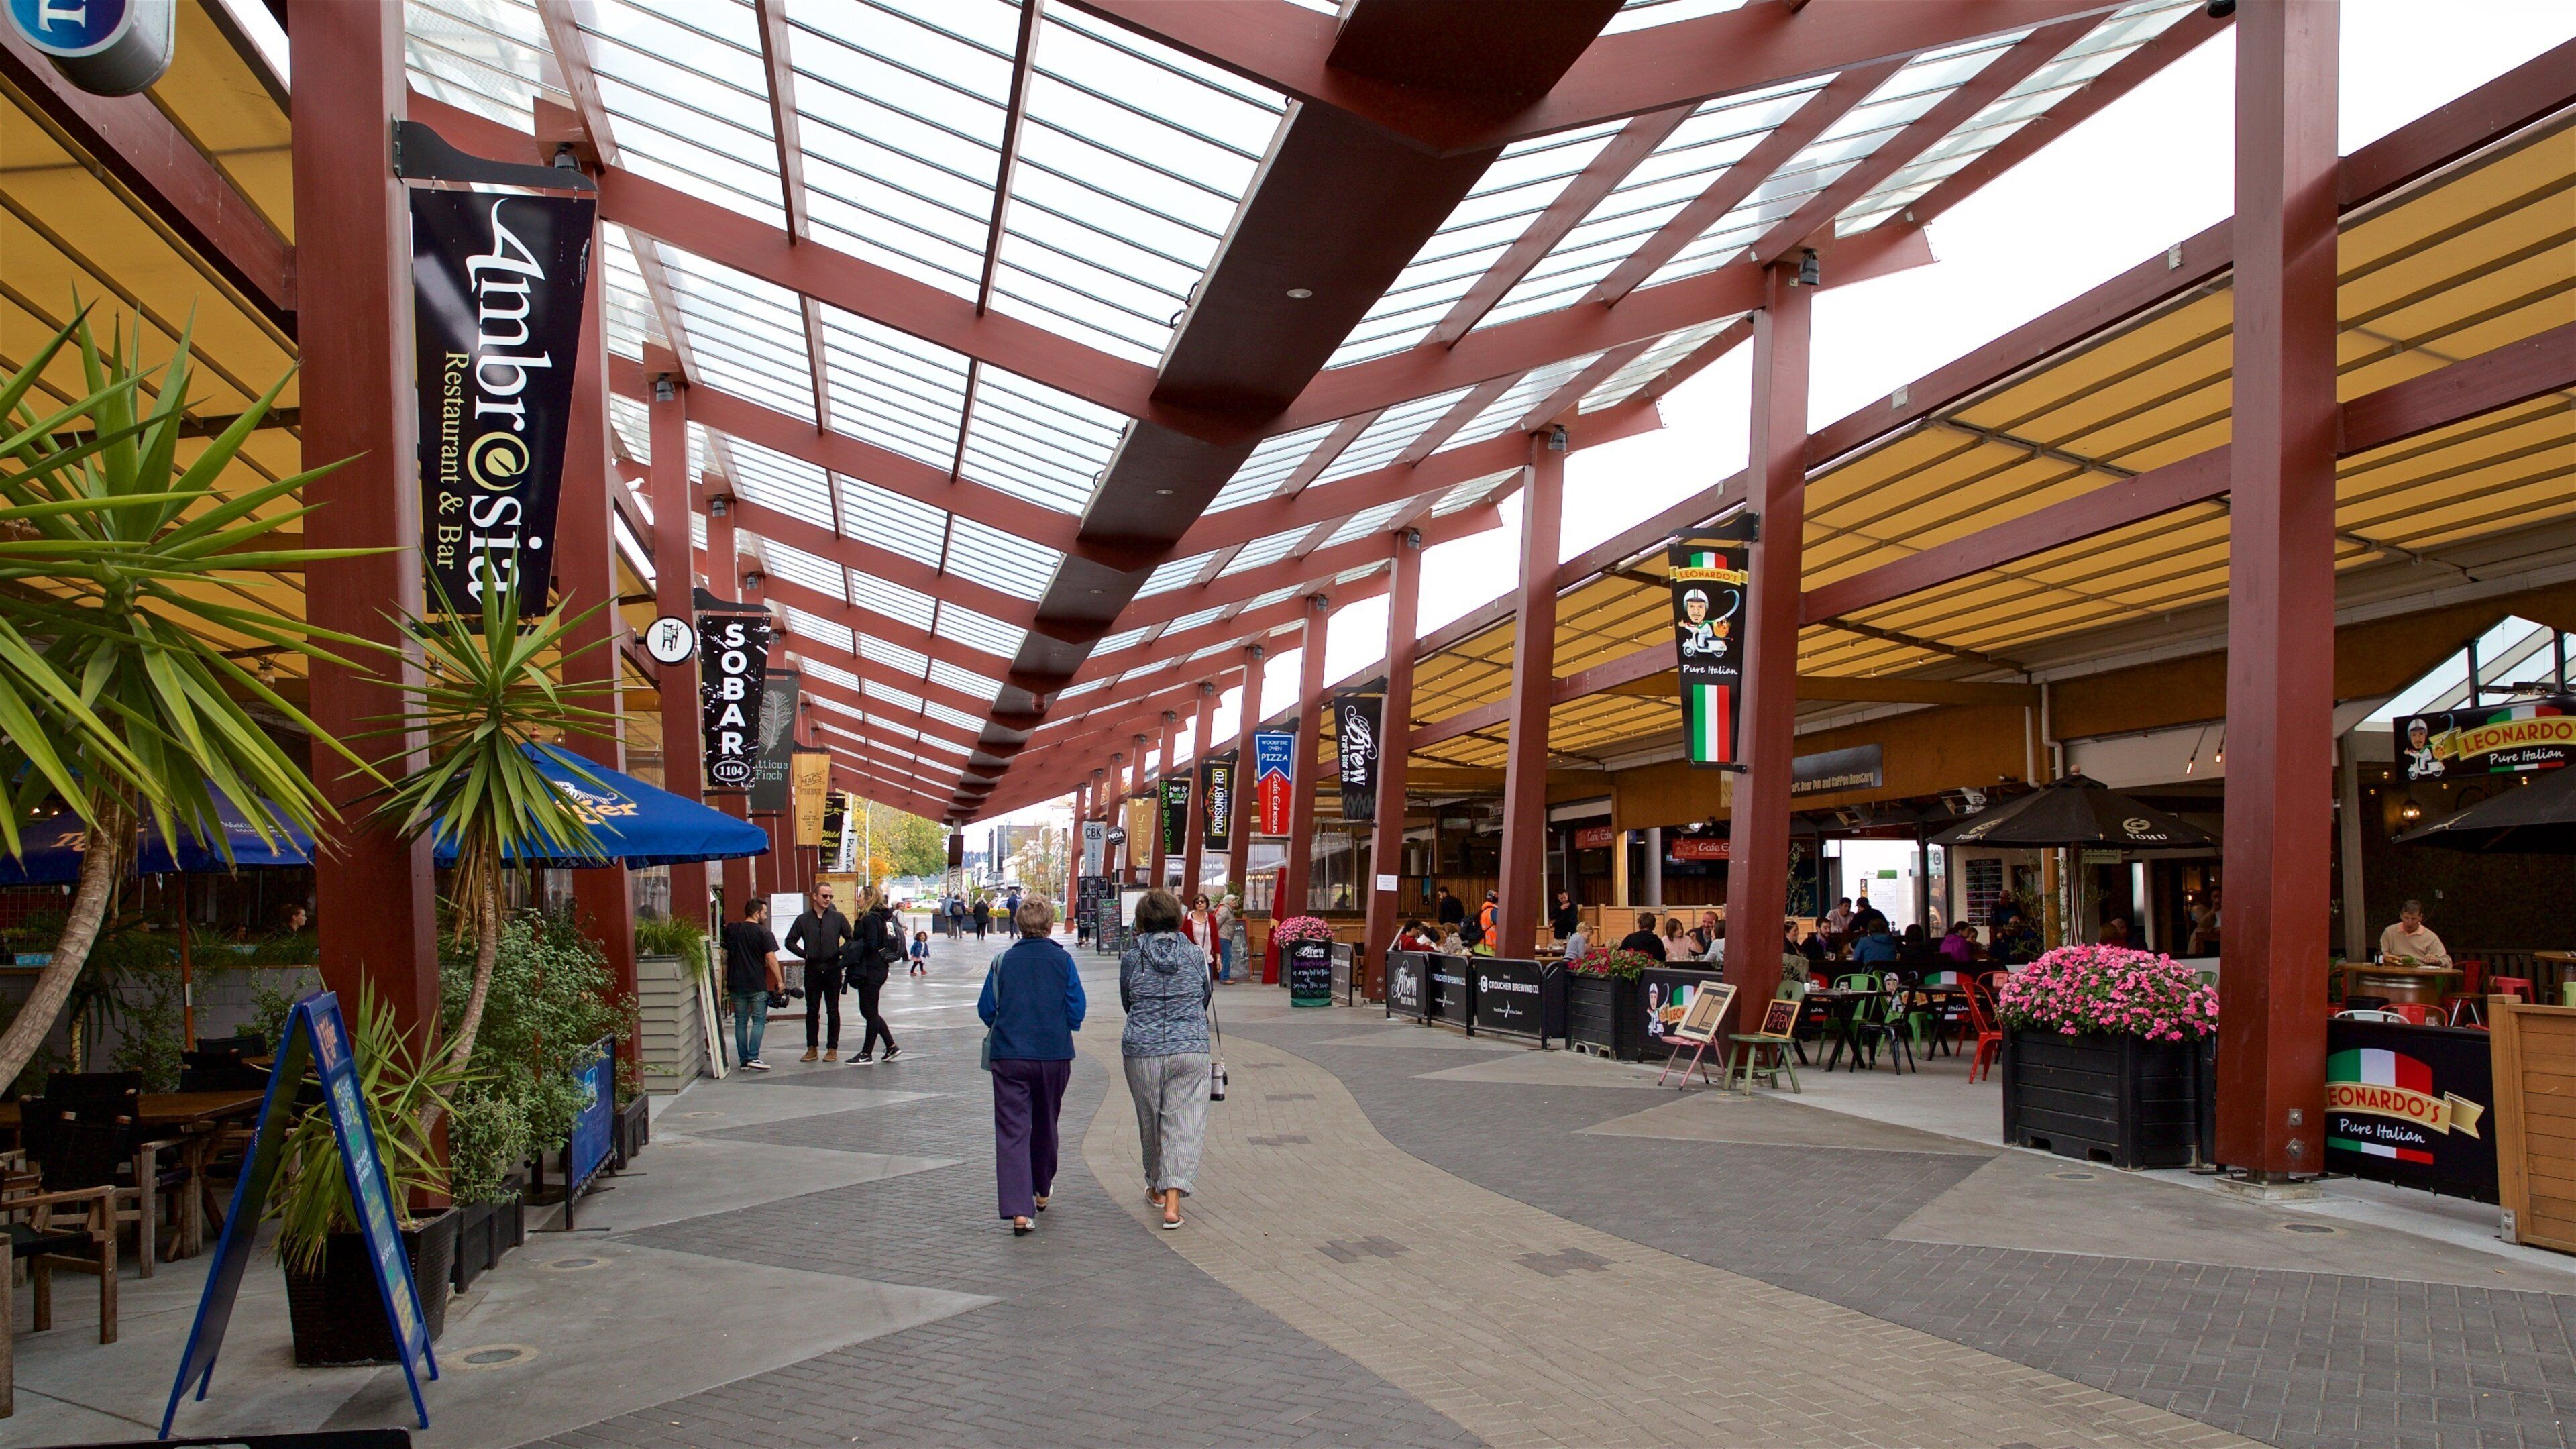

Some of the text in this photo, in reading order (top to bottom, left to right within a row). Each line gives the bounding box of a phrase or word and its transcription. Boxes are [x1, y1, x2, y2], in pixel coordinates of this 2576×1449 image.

[437, 350, 470, 570] Restaurant & Bar
[1679, 569, 1738, 582] LEONARDO'S
[1682, 664, 1738, 675] Pure Italian
[2463, 722, 2576, 754] LEONARDO
[1261, 753, 1289, 762] PIZZA
[2489, 748, 2565, 765] Pure Italian
[719, 765, 743, 777] 1104
[756, 769, 783, 781] Finch
[1792, 782, 1801, 793] aft
[1213, 771, 1224, 834] PONSONBY RD
[1272, 773, 1281, 833] Cafe Ephesus
[821, 830, 840, 838] Wild
[1086, 828, 1102, 837] CBK
[1108, 832, 1124, 840] MOA
[1136, 812, 1147, 850] Solace
[821, 839, 839, 848] Rice
[1699, 842, 1720, 853] Cafe
[1391, 959, 1417, 999] Brew
[1489, 981, 1511, 991] CROUCHER
[1512, 983, 1533, 994] BREWING
[1767, 1012, 1792, 1030] OPEN
[2325, 1086, 2440, 1123] EONARDO'S
[2340, 1118, 2426, 1144] Pure Italian
